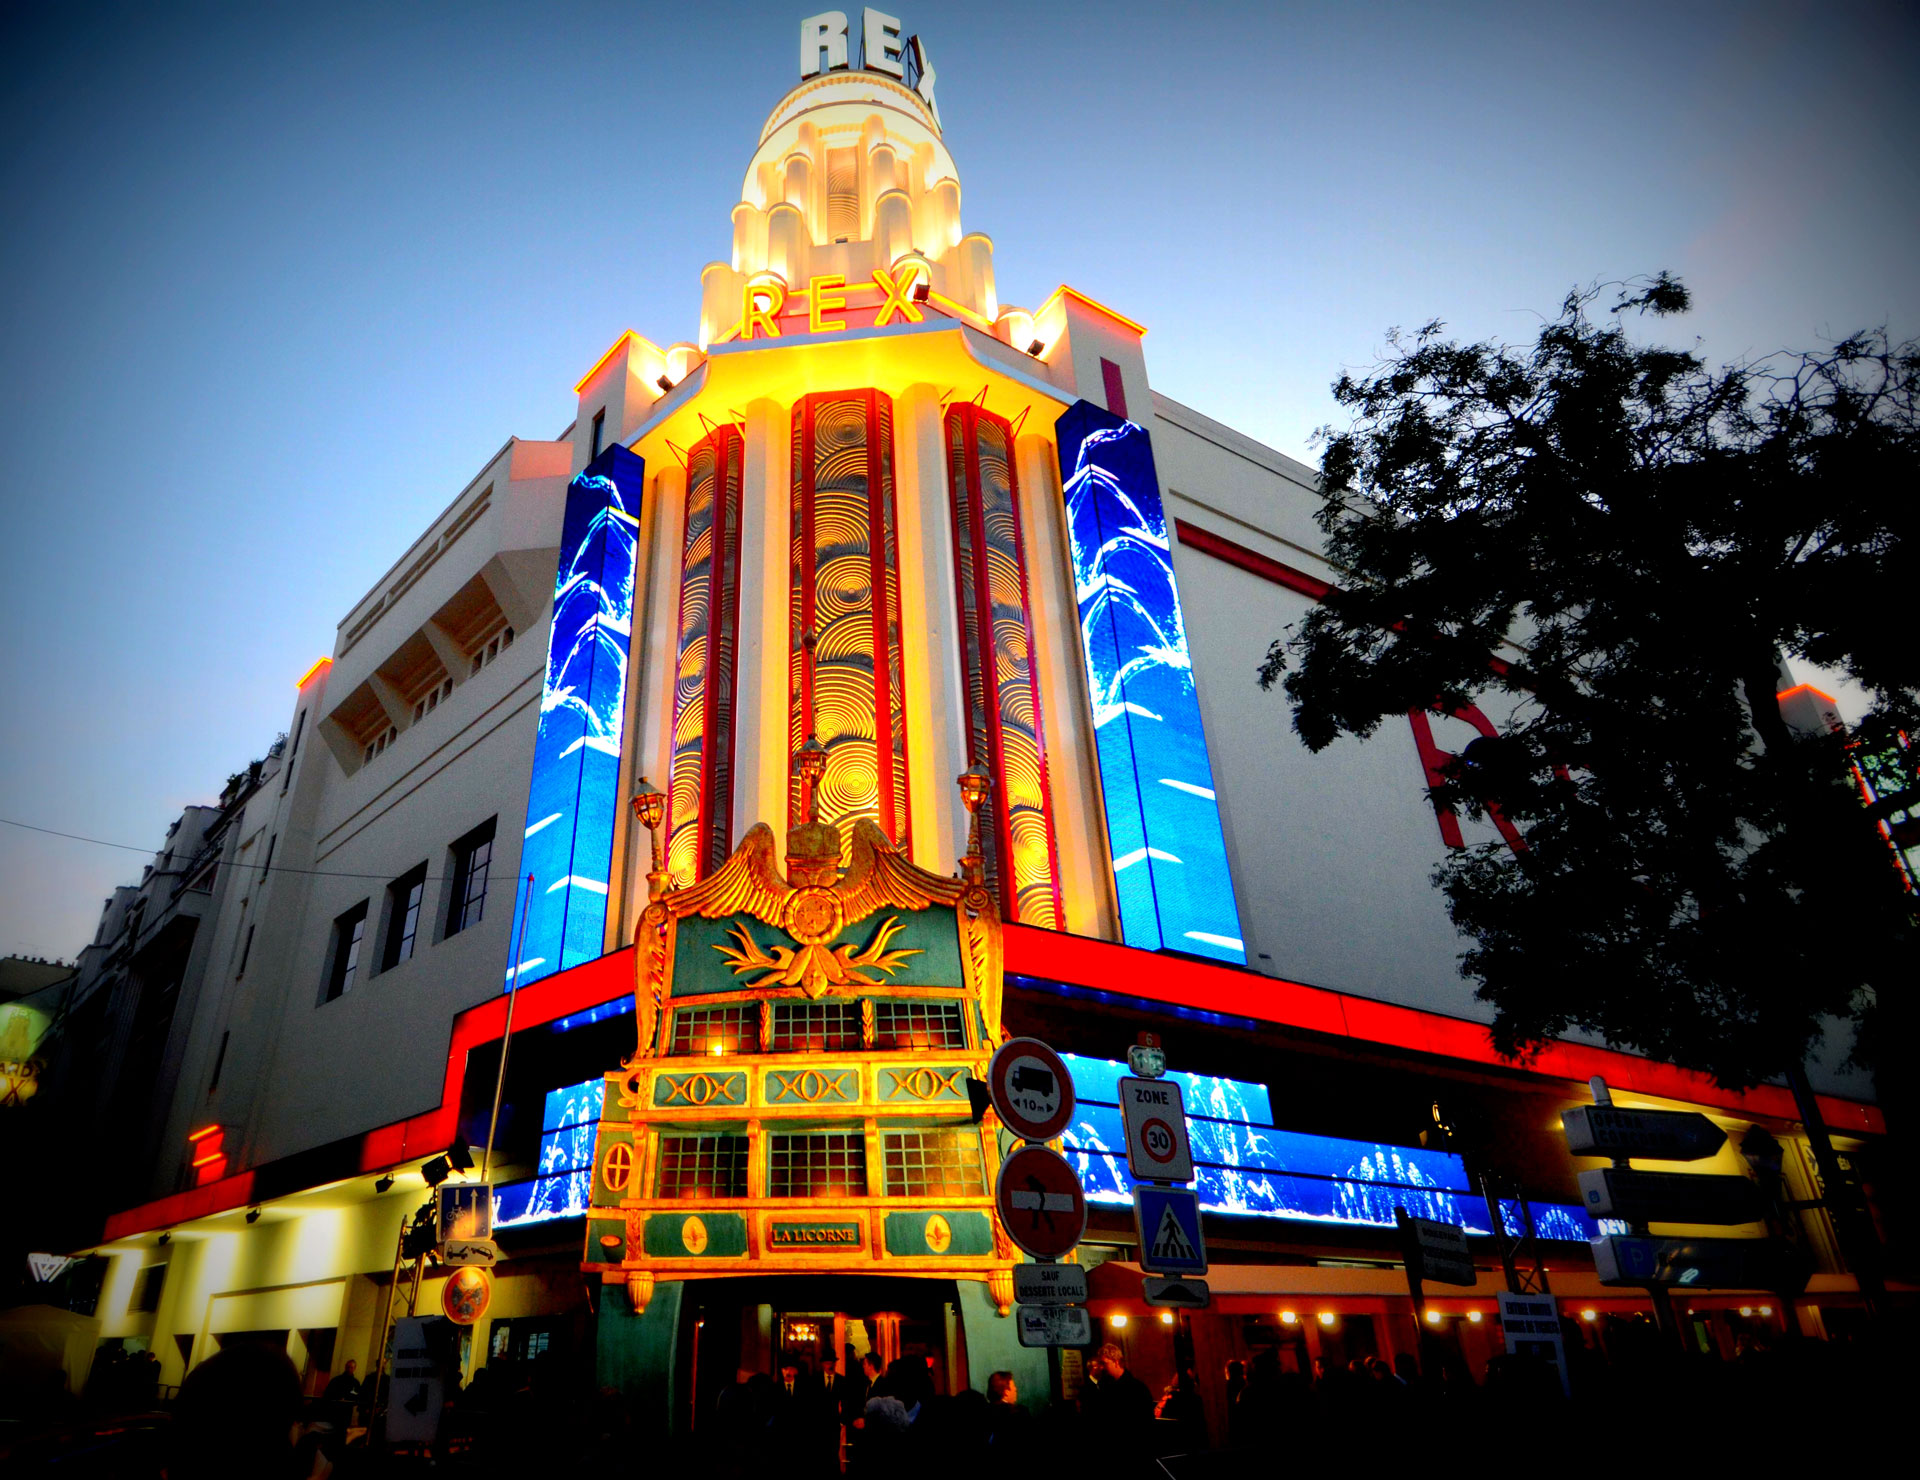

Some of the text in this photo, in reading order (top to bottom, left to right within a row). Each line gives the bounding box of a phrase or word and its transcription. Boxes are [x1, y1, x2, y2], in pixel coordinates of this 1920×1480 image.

[801, 7, 942, 134] REX
[741, 267, 923, 339] REX
[1135, 1089, 1170, 1105] ZONE
[1149, 1131, 1169, 1149] 30
[772, 1228, 855, 1242] LA LICORNE
[1629, 1247, 1645, 1265] P
[1041, 1270, 1060, 1281] SAUF
[1020, 1286, 1084, 1297] DESSERTE LOCALE
